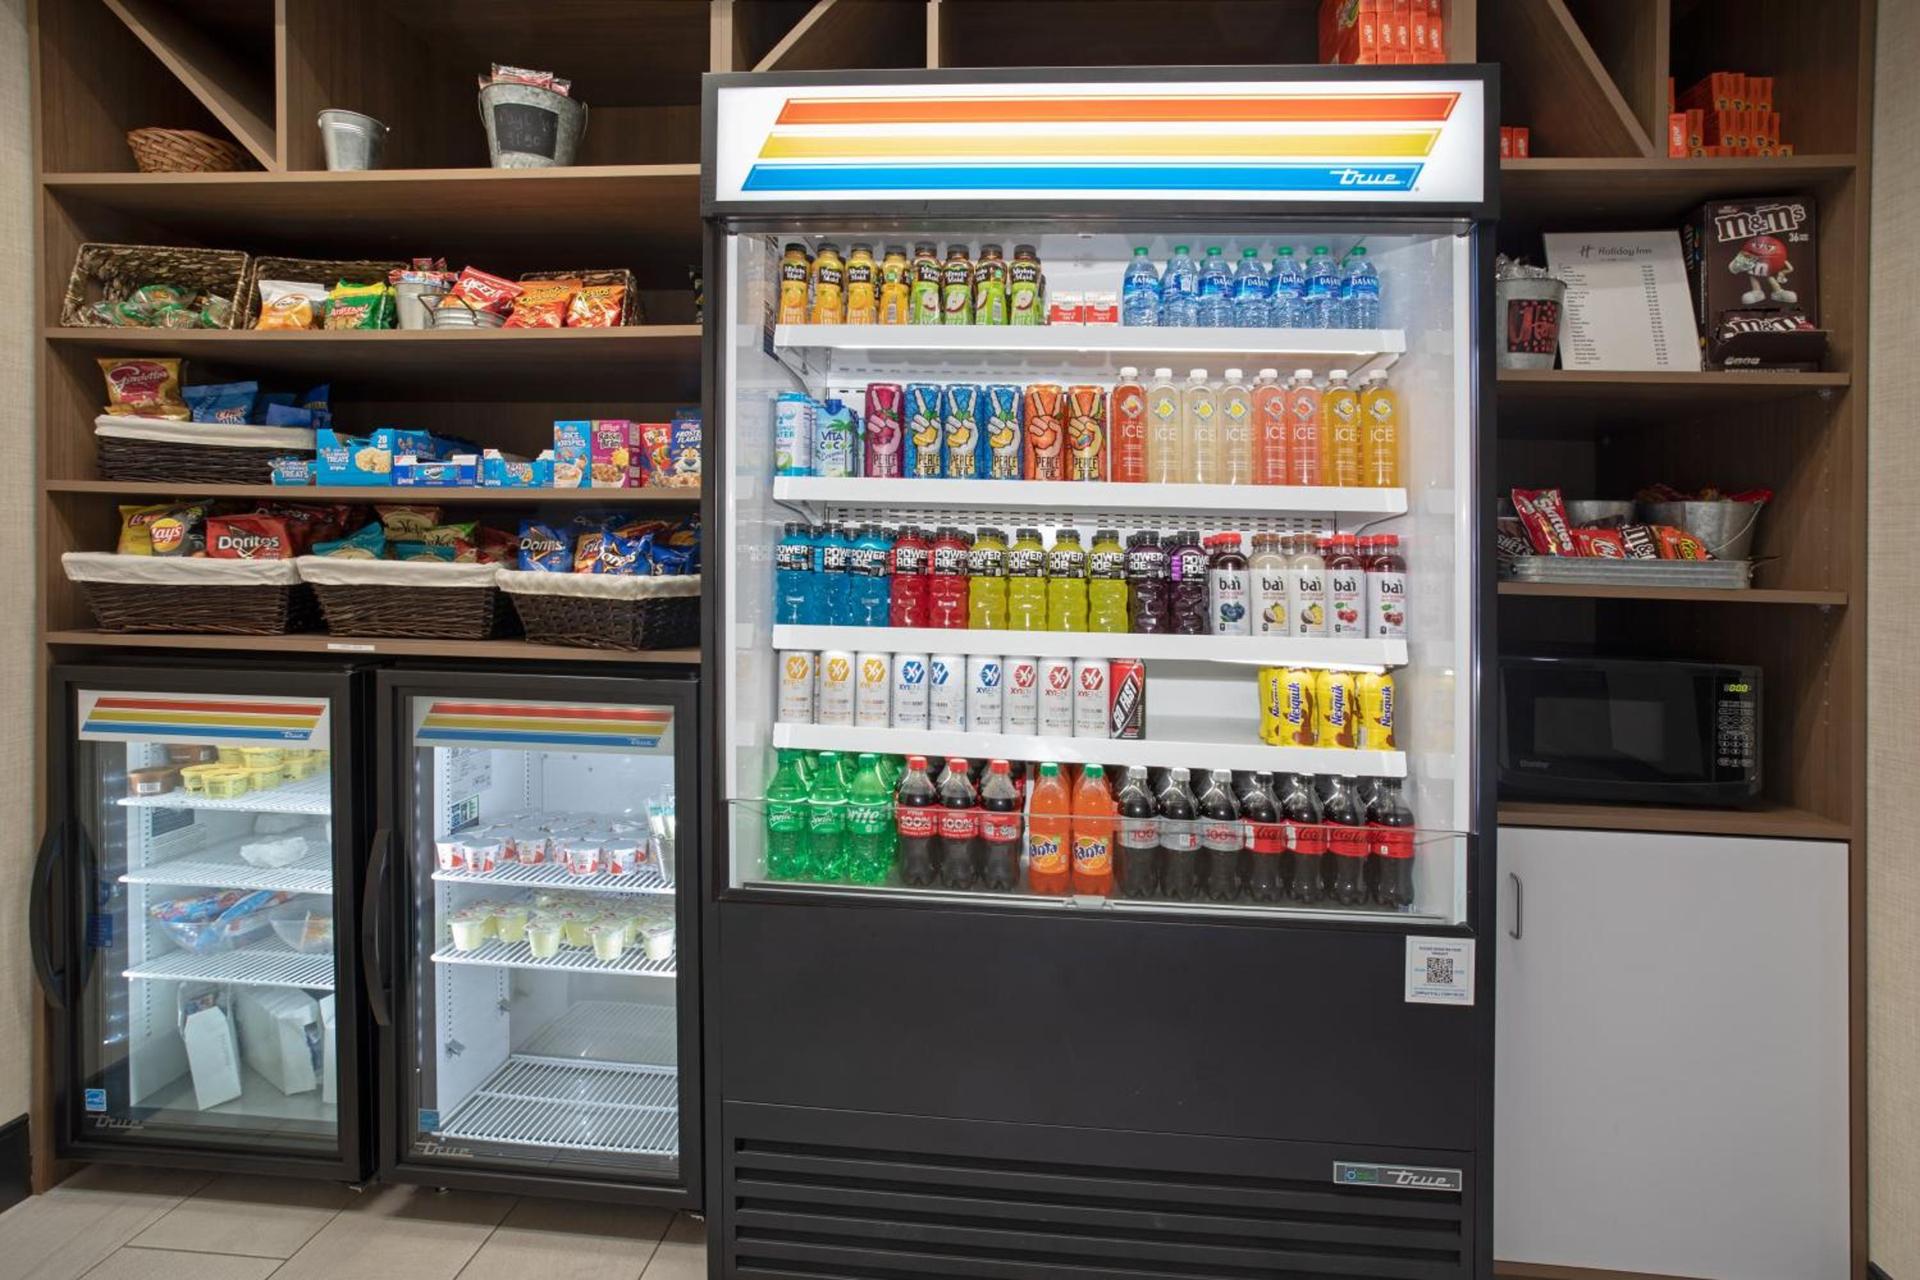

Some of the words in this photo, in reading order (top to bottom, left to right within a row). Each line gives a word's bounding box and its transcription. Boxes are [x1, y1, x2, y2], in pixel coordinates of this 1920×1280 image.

[1598, 246, 1634, 257] Holiday
[1636, 246, 1652, 255] Inn
[821, 431, 844, 441] VITA
[1122, 424, 1144, 438] ICE
[1154, 428, 1176, 440] ICE
[1194, 428, 1216, 441] ICE
[1226, 427, 1248, 440] ICE
[1265, 426, 1286, 440] ICE
[1293, 426, 1317, 440] ICE
[1335, 428, 1357, 440] ICE
[1370, 428, 1393, 441] ICE
[1036, 456, 1060, 468] PEACE
[218, 534, 280, 550] Doritos
[824, 556, 846, 566] ADE
[896, 557, 917, 567] ADE
[935, 557, 957, 567] ADE
[968, 551, 1001, 561] POWER
[1009, 551, 1043, 561] POWER
[1050, 551, 1084, 561] POWER
[1091, 552, 1124, 562] POWER
[1129, 552, 1163, 561] POWER
[1182, 564, 1205, 574] ADE
[1219, 576, 1241, 590] bai
[1262, 576, 1284, 591] bai
[1300, 576, 1322, 592] bai
[1334, 577, 1357, 592] bai
[1381, 579, 1404, 594] bai
[1287, 682, 1303, 724] Nesquik
[1330, 684, 1346, 726] Nesquik
[1381, 686, 1393, 727] Nesquik
[848, 807, 879, 823] rite
[900, 815, 930, 828] 100%
[942, 817, 973, 829] 100%
[1030, 842, 1057, 858] anta
